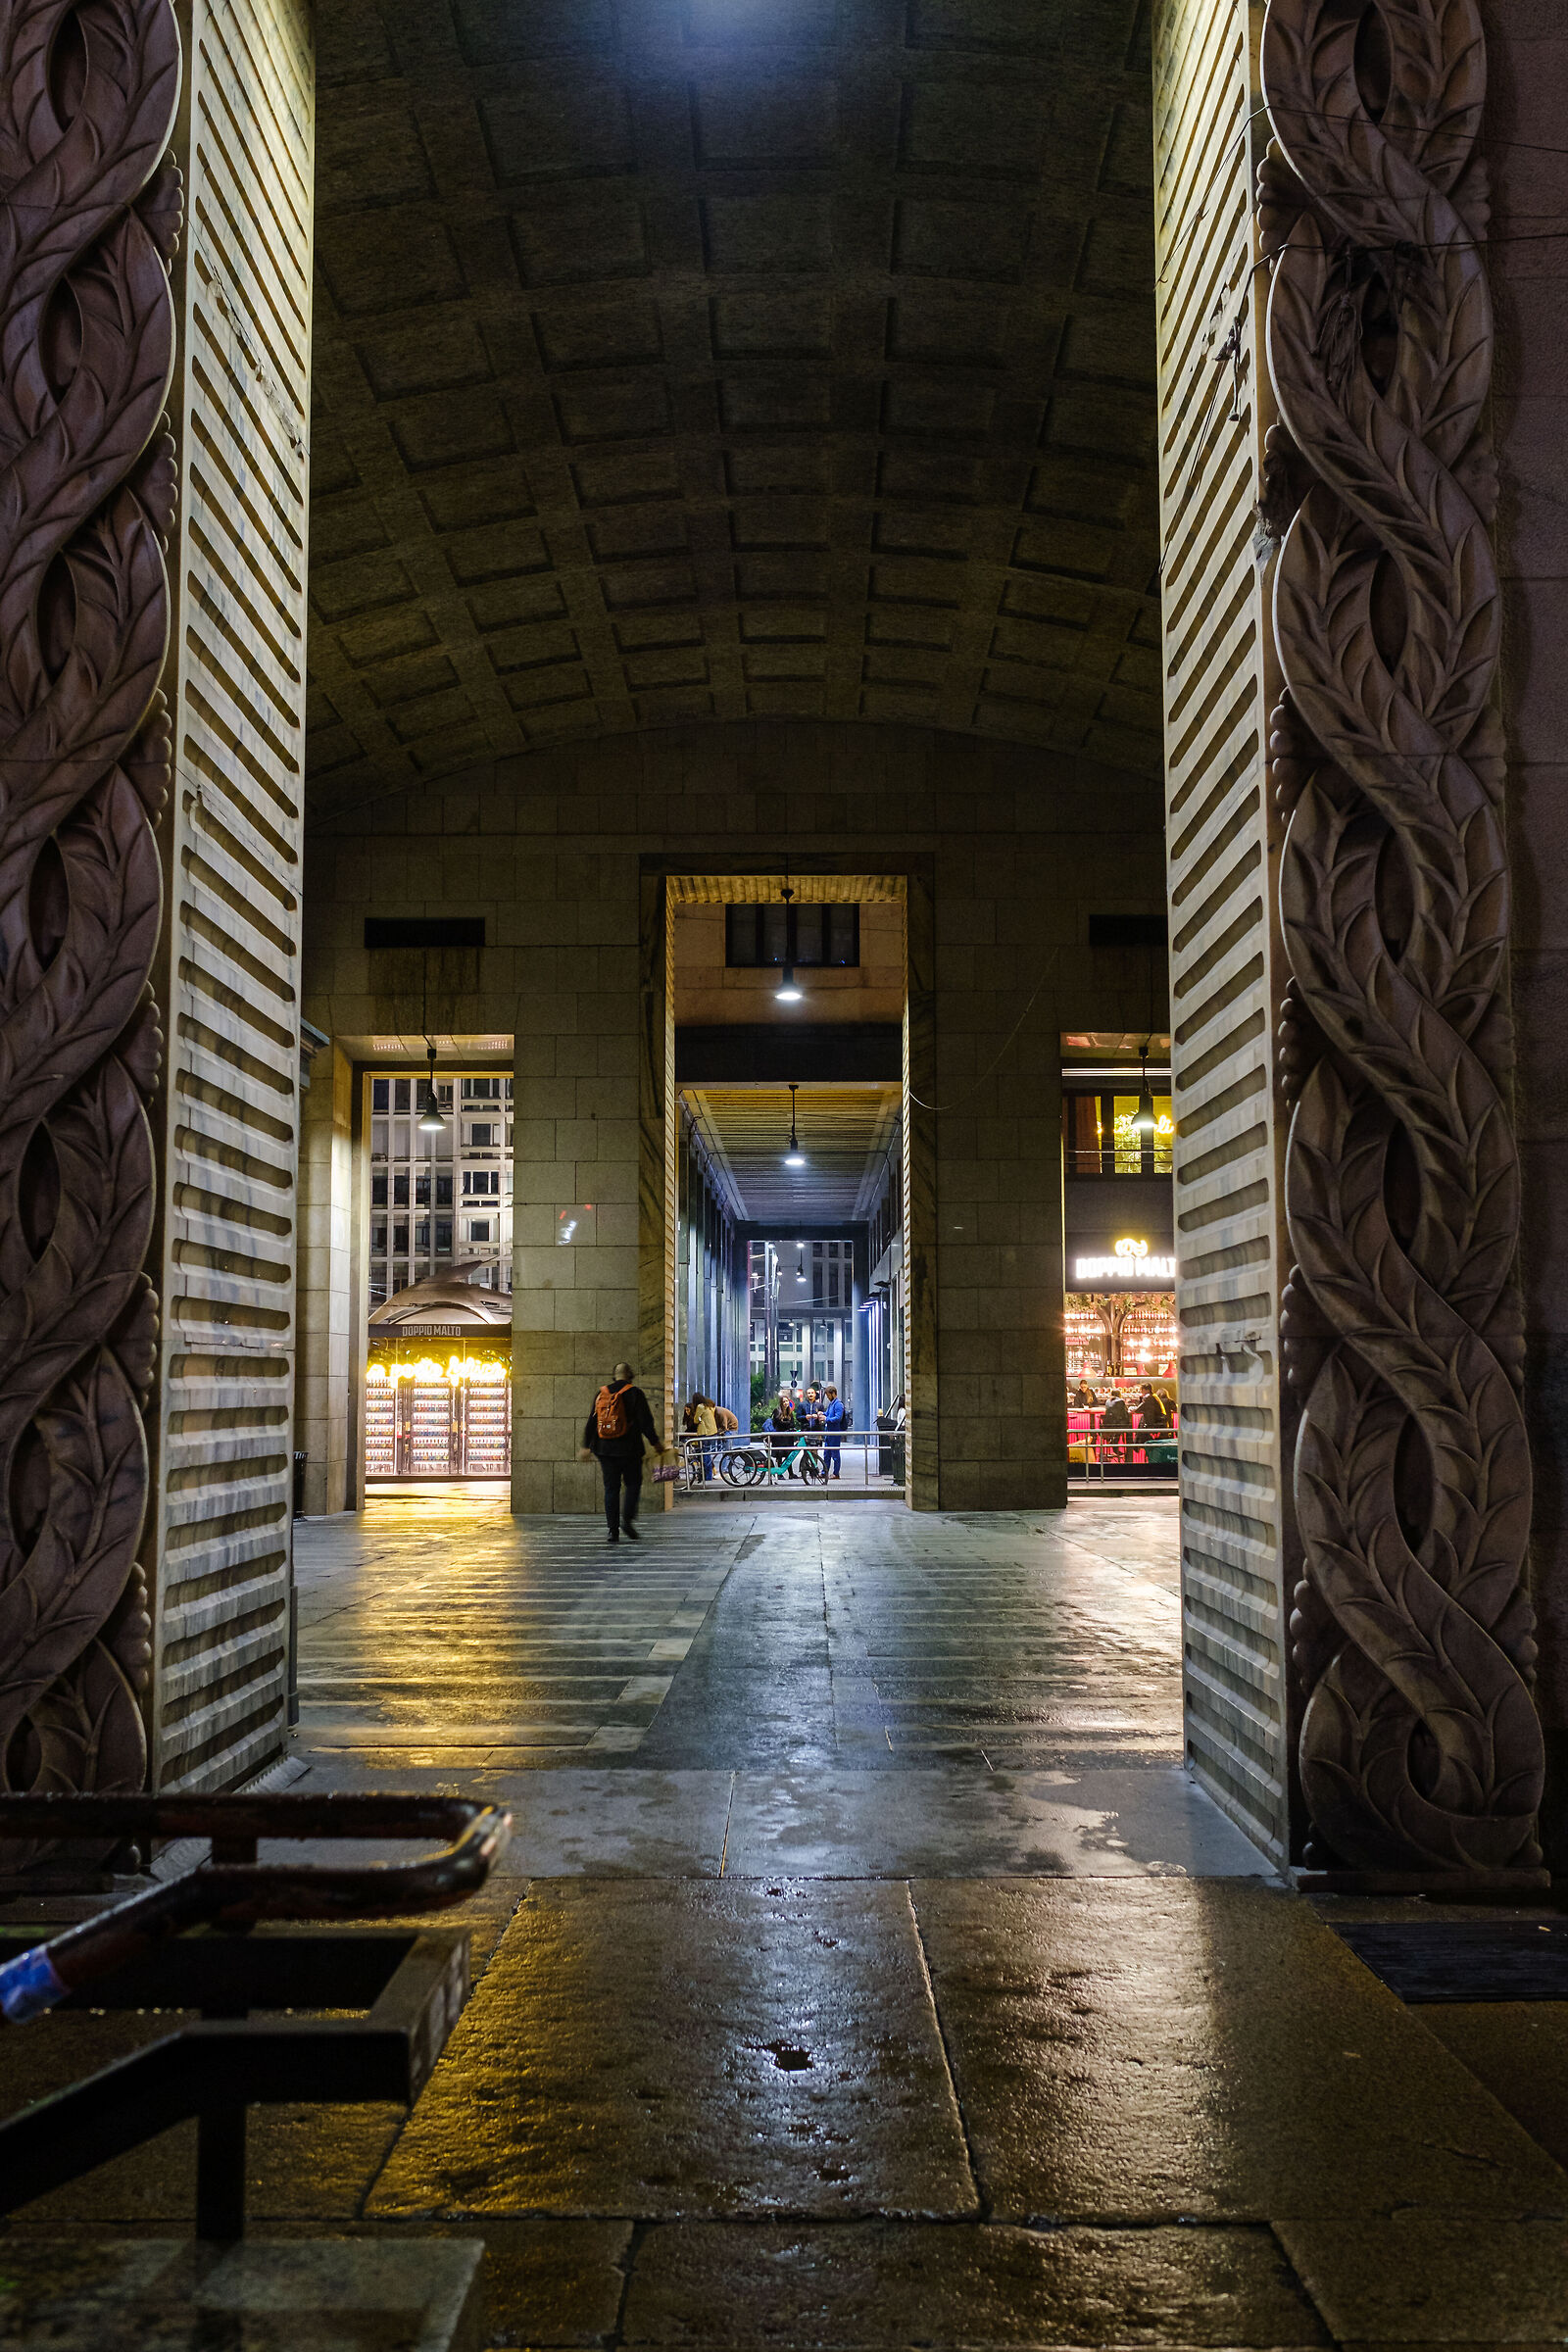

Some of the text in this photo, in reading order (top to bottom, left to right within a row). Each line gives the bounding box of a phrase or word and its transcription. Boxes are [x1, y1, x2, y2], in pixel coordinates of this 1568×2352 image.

[1076, 1256, 1176, 1278] DOPPIO MALT
[402, 1325, 462, 1337] DOPPIO MALTO
